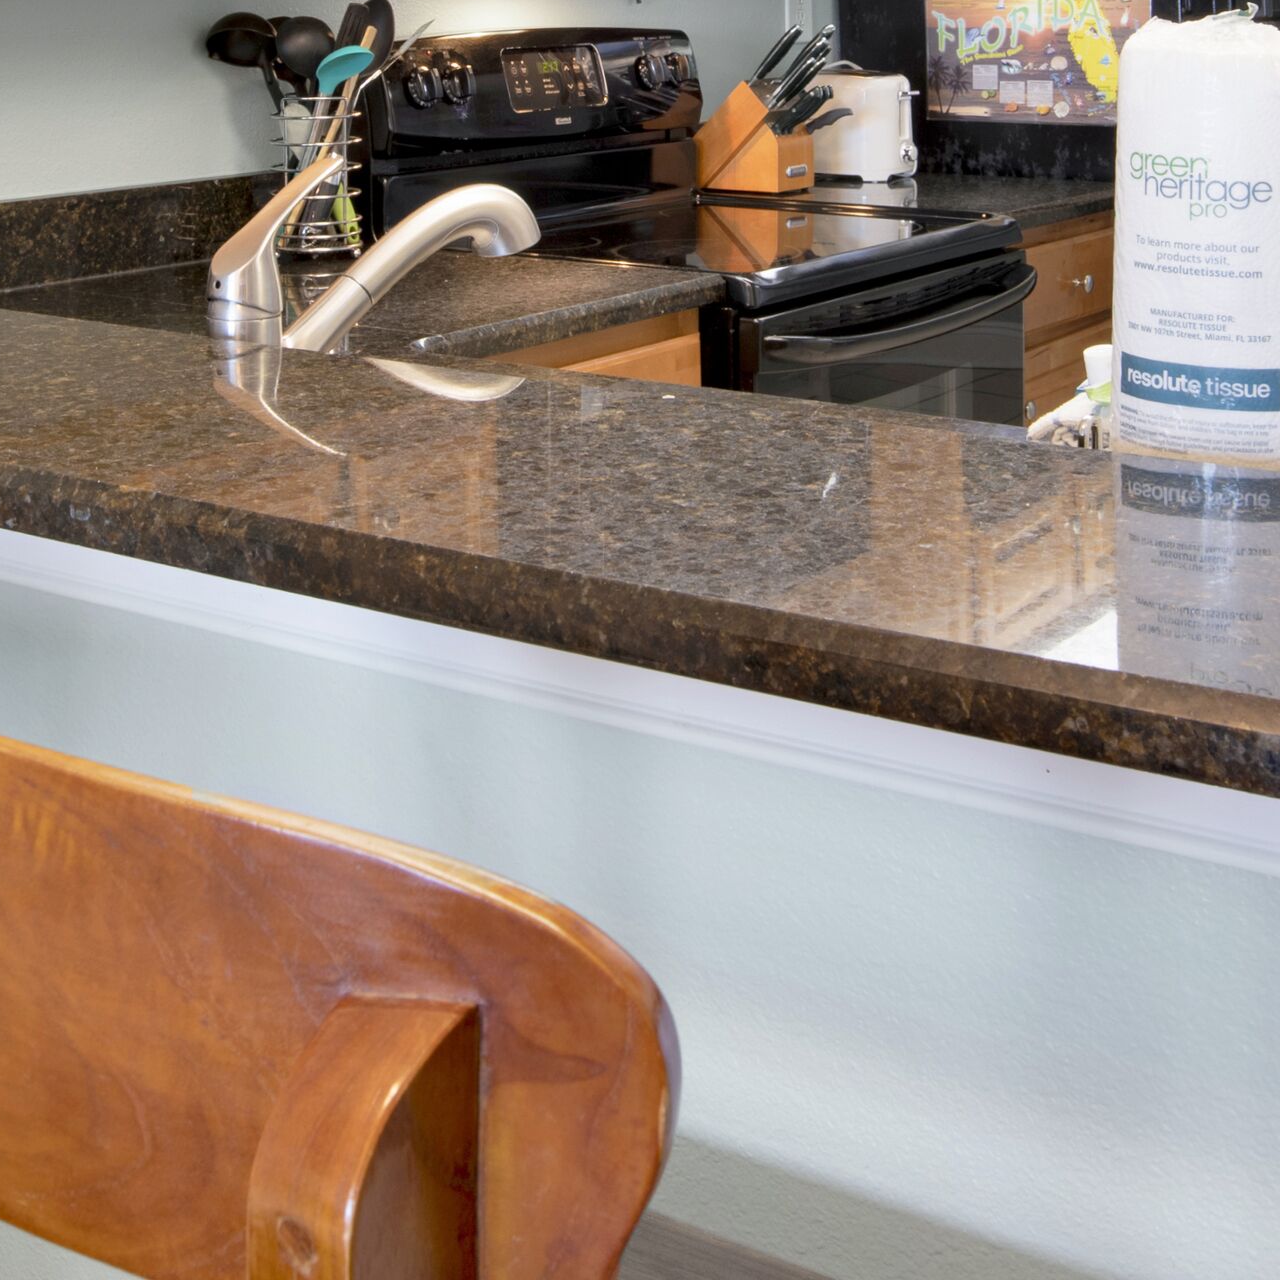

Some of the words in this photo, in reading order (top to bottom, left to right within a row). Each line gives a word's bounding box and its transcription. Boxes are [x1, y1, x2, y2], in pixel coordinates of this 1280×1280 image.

[1130, 151, 1208, 180] green
[1144, 172, 1273, 210] heritage
[1189, 202, 1228, 221] pro
[1136, 234, 1146, 245] To
[1147, 236, 1171, 248] learn
[1173, 241, 1201, 251] more
[1204, 242, 1237, 253] about
[1240, 245, 1261, 254] our
[1156, 252, 1202, 264] products
[1133, 260, 1263, 279] www.resolutetissue.com
[1150, 307, 1215, 322] MANUFACTURED
[1158, 318, 1196, 330] RESOLUTE
[1199, 323, 1227, 332] TISSUE
[1235, 334, 1246, 342] FL
[1127, 367, 1201, 395] resolute
[1205, 377, 1271, 398] tissue
